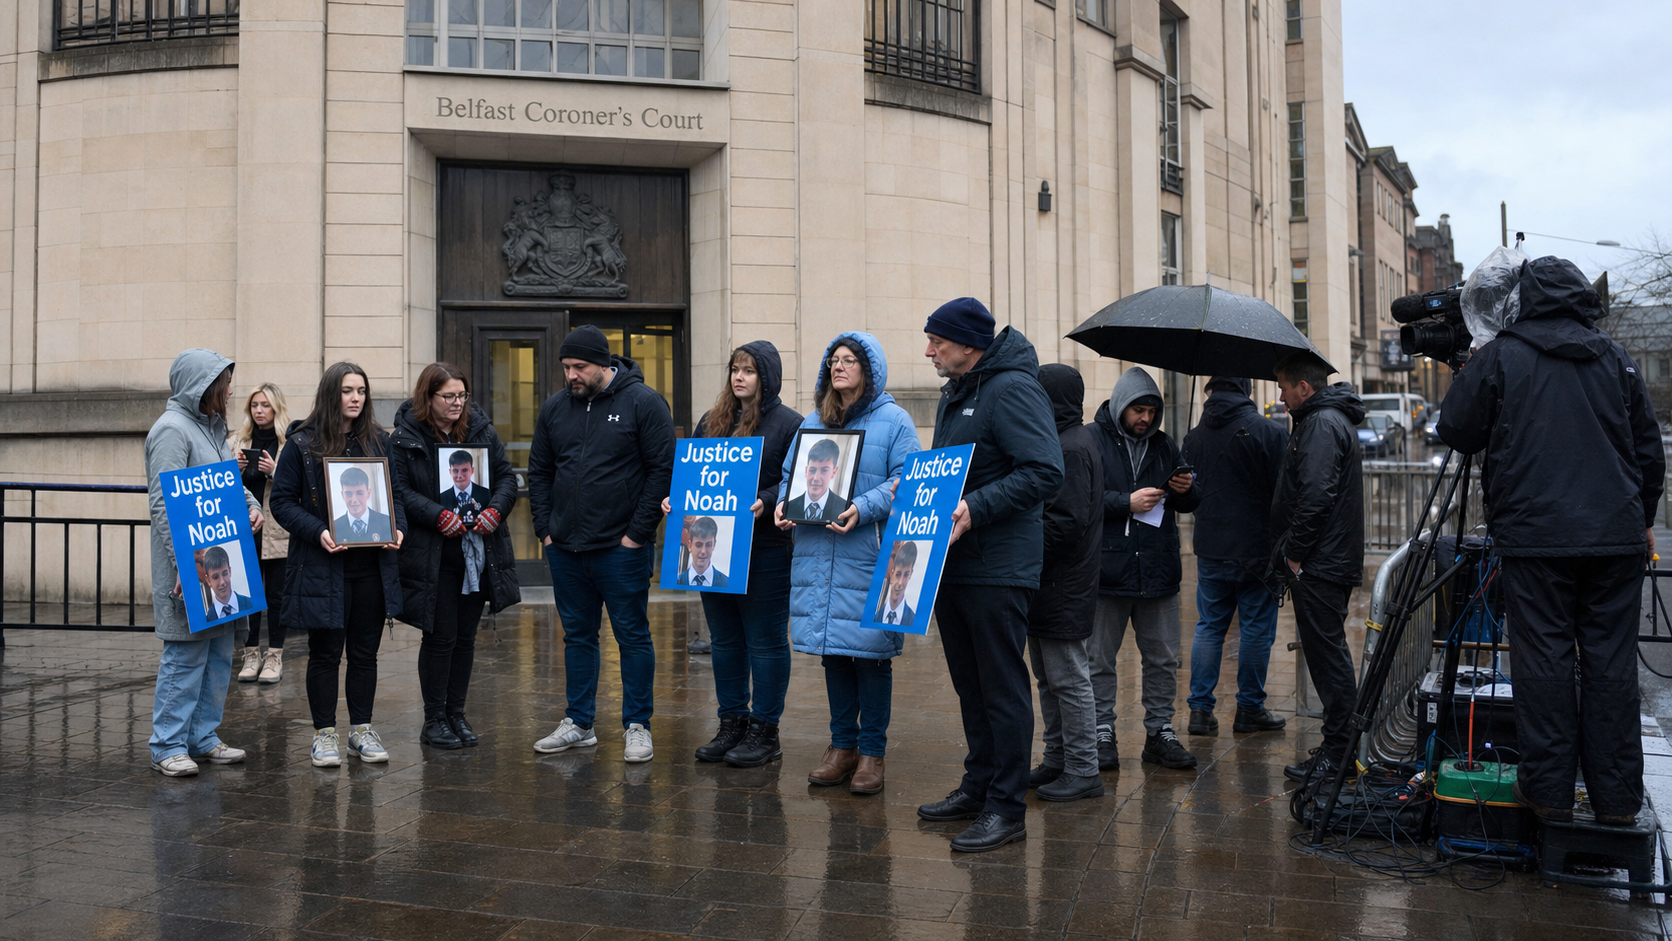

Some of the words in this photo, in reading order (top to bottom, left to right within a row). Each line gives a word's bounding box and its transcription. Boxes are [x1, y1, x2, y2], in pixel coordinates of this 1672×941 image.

[435, 96, 516, 121] Belfast
[641, 107, 704, 130] Court
[681, 440, 753, 463] Justice
[700, 465, 730, 487] for
[905, 454, 963, 481] Justice
[170, 468, 235, 498] Justice
[914, 482, 938, 507] for
[195, 495, 222, 518] for
[684, 489, 738, 512] Noah
[188, 515, 238, 546] Noah
[896, 510, 939, 536] Noah
